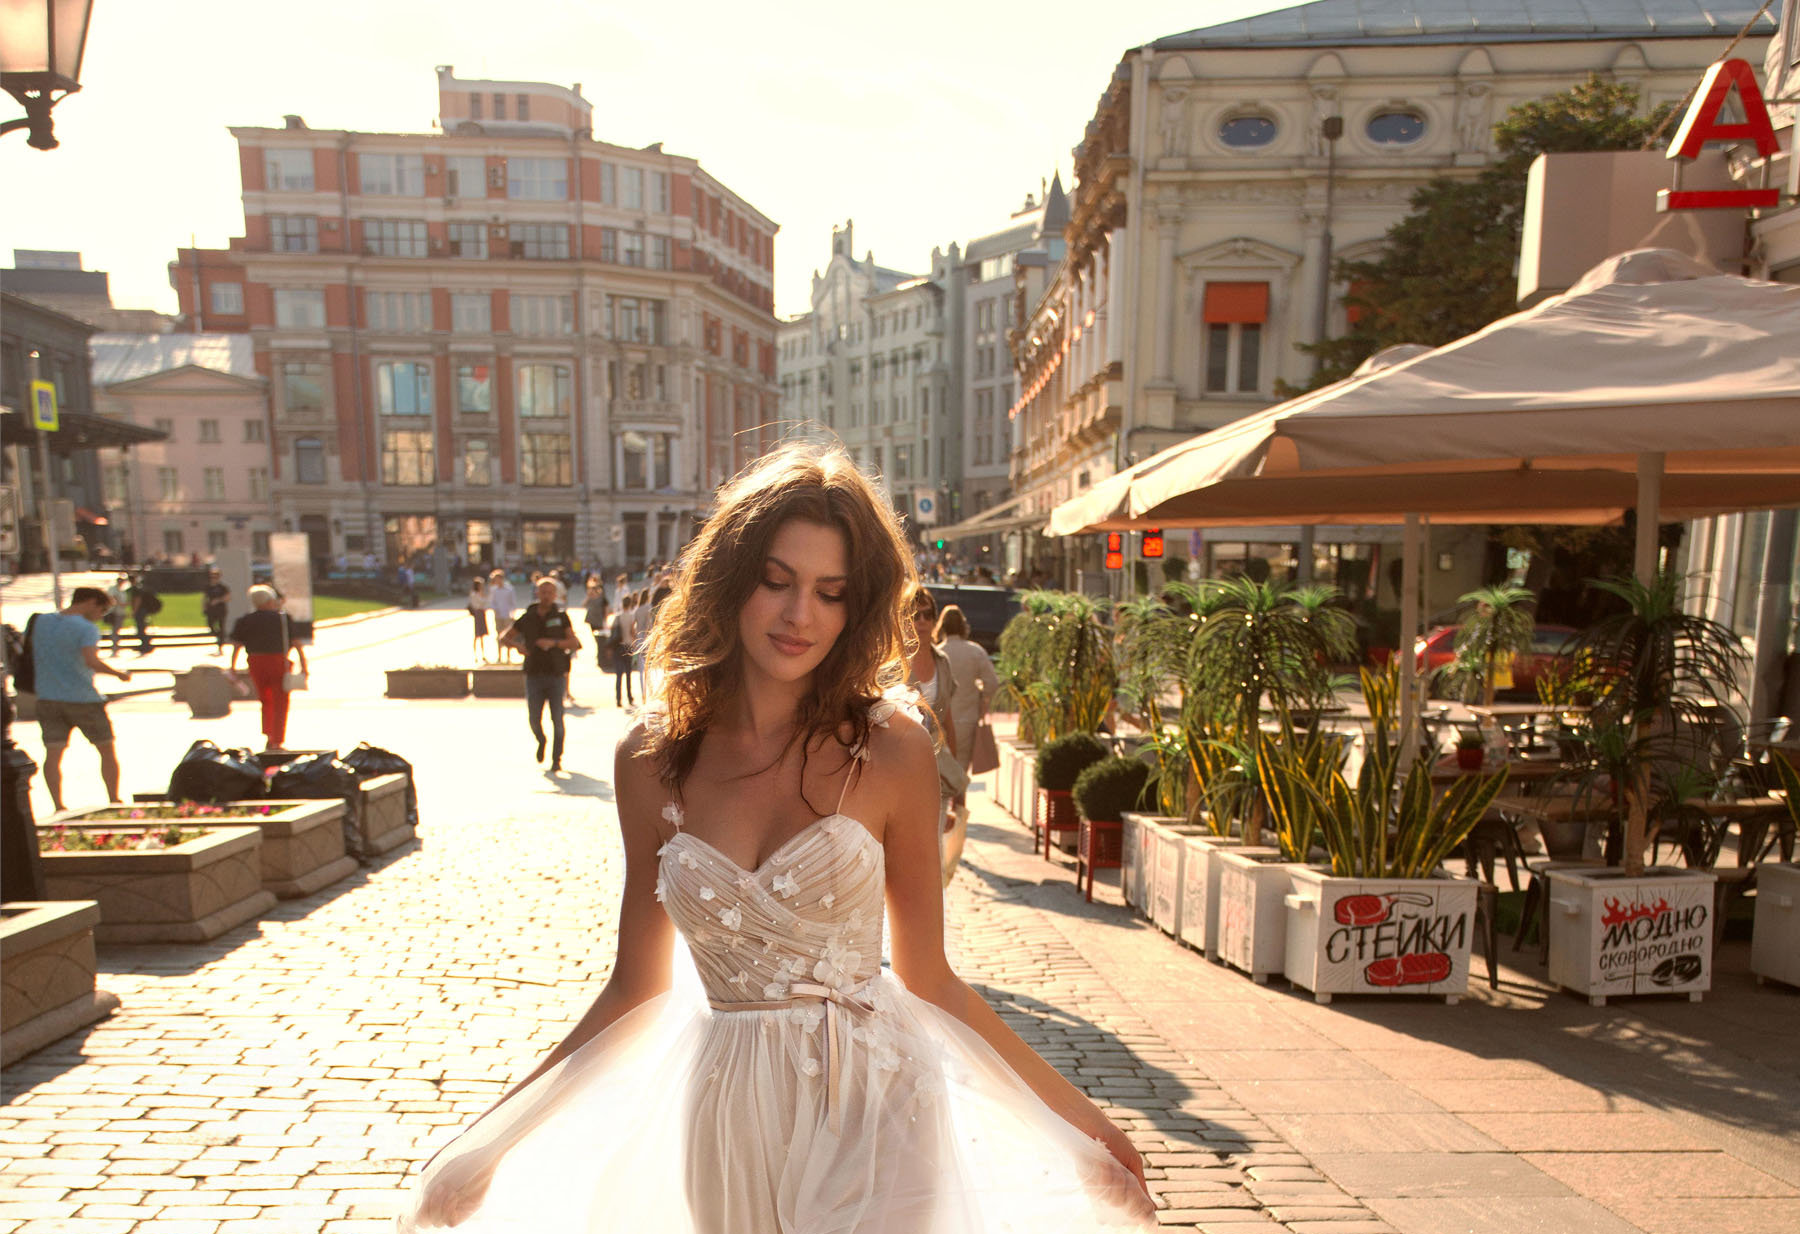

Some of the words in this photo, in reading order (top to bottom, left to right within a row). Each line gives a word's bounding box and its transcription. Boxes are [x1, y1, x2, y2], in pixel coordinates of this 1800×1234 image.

[1325, 912, 1467, 964] СТЕЙКИ
[1601, 904, 1708, 951] МОДНО
[1599, 935, 1703, 970] СКОВОРОДНО
